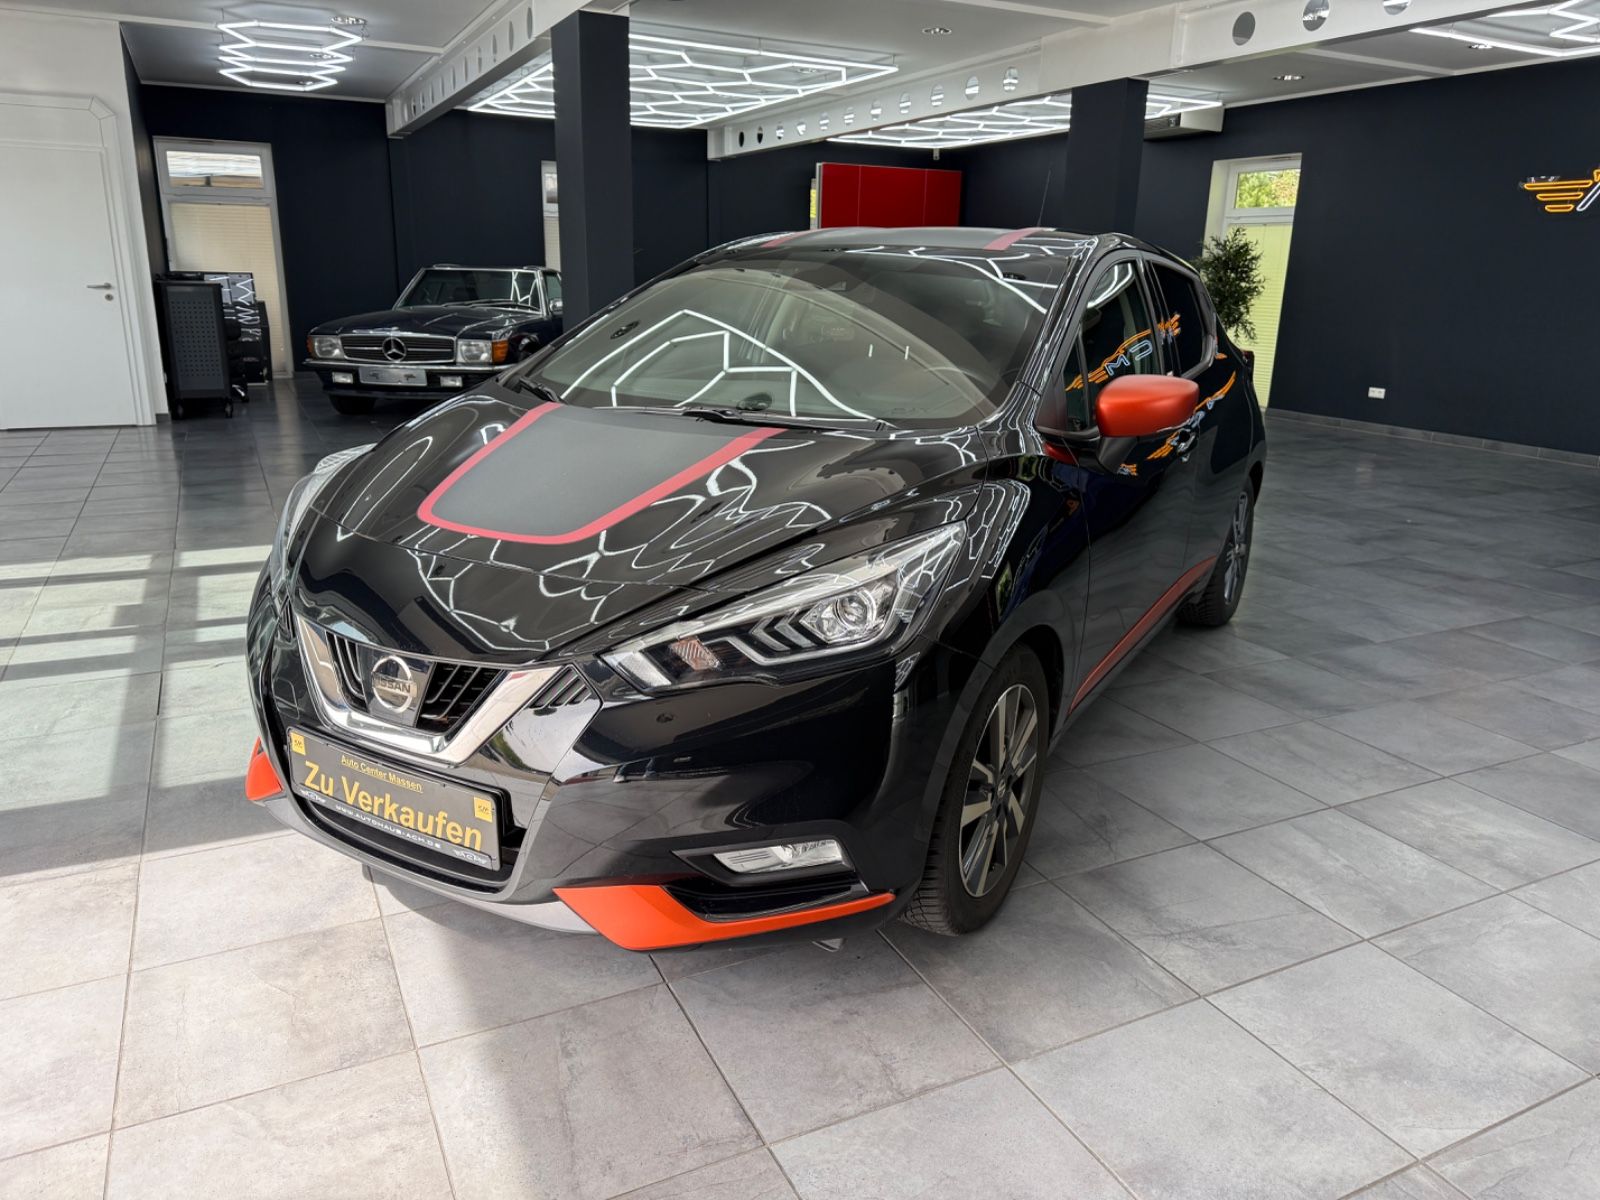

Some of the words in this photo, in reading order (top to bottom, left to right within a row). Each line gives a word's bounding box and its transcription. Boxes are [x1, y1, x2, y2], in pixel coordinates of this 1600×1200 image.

[341, 754, 359, 769] Auto
[360, 763, 388, 781] Center
[304, 760, 334, 797] Zu
[341, 775, 482, 851] Verkaufen
